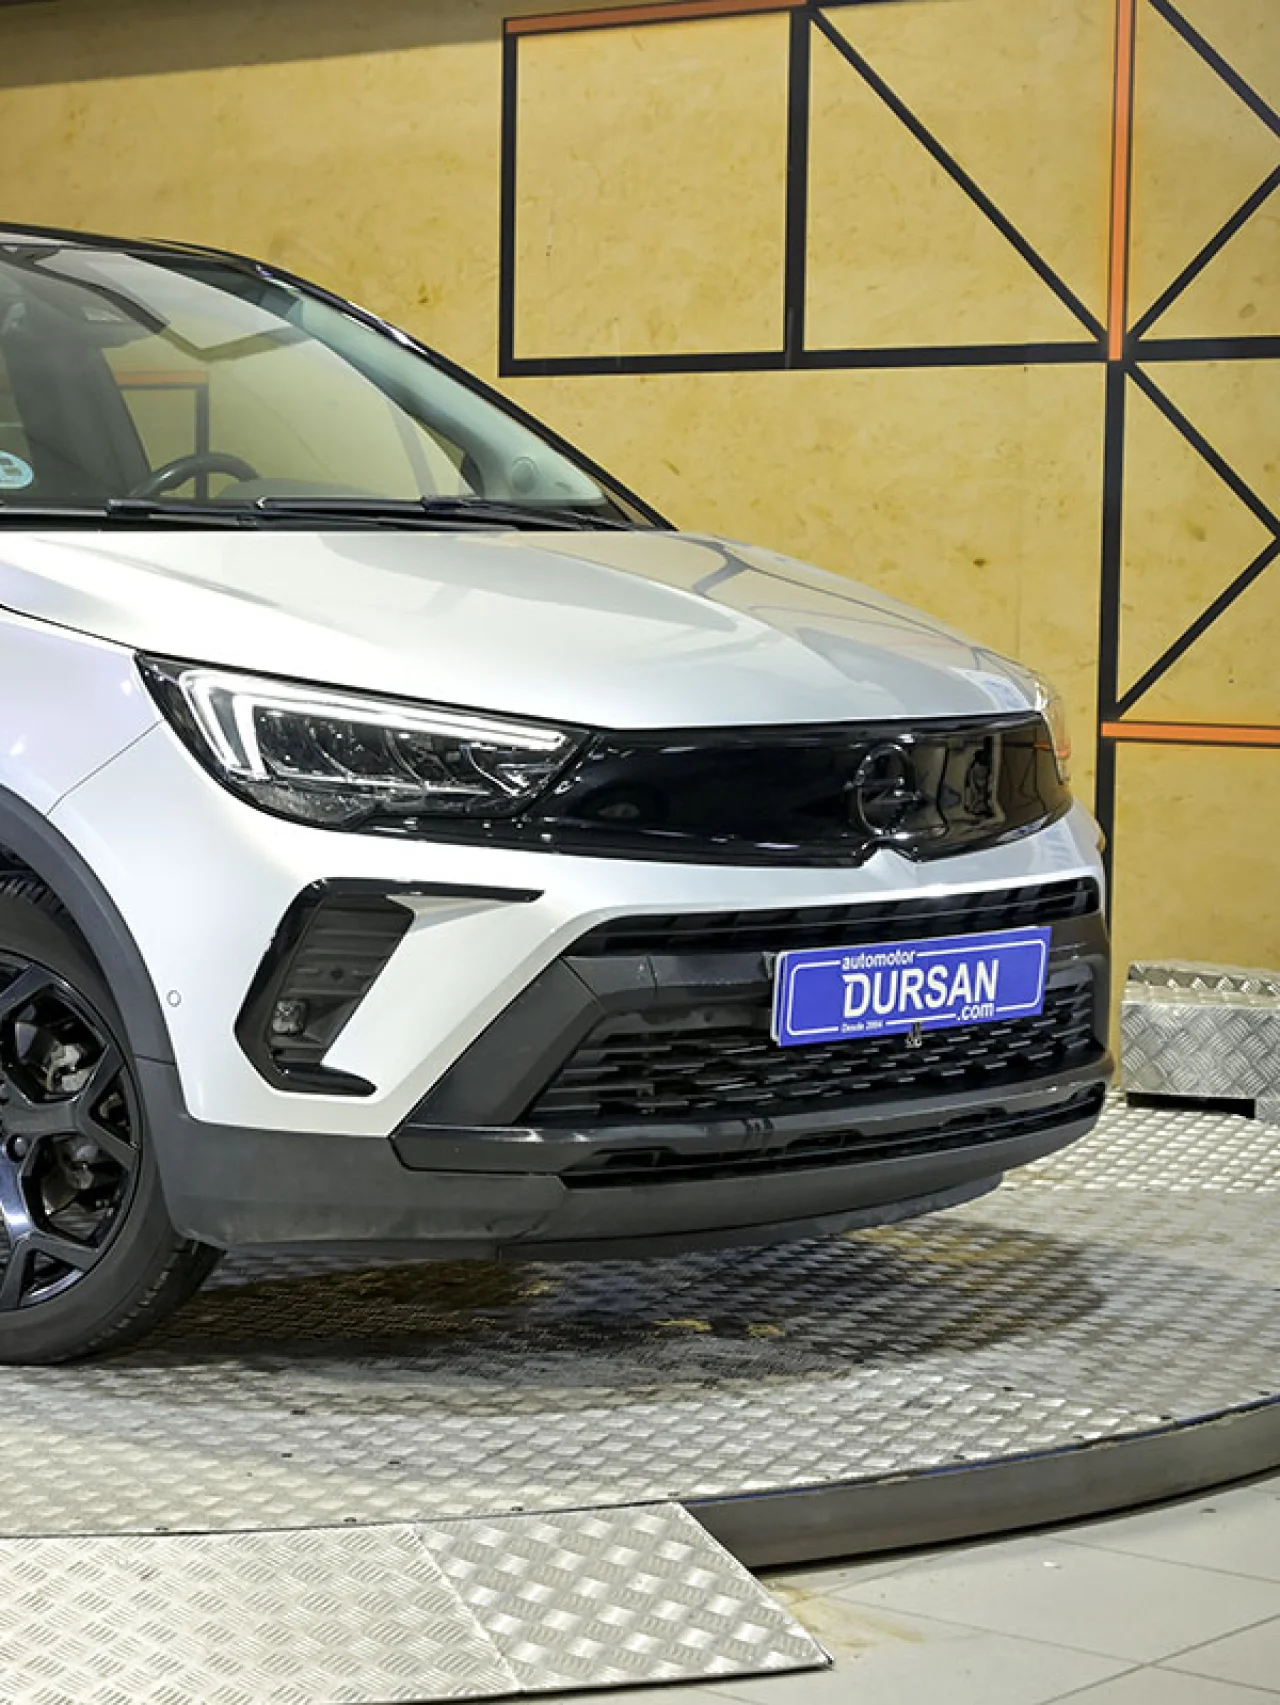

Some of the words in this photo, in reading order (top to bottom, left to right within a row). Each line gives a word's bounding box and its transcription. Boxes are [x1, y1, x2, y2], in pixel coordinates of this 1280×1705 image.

[842, 949, 917, 971] automotor
[842, 959, 999, 1019] DURSAN
[956, 1001, 995, 1022] .com
